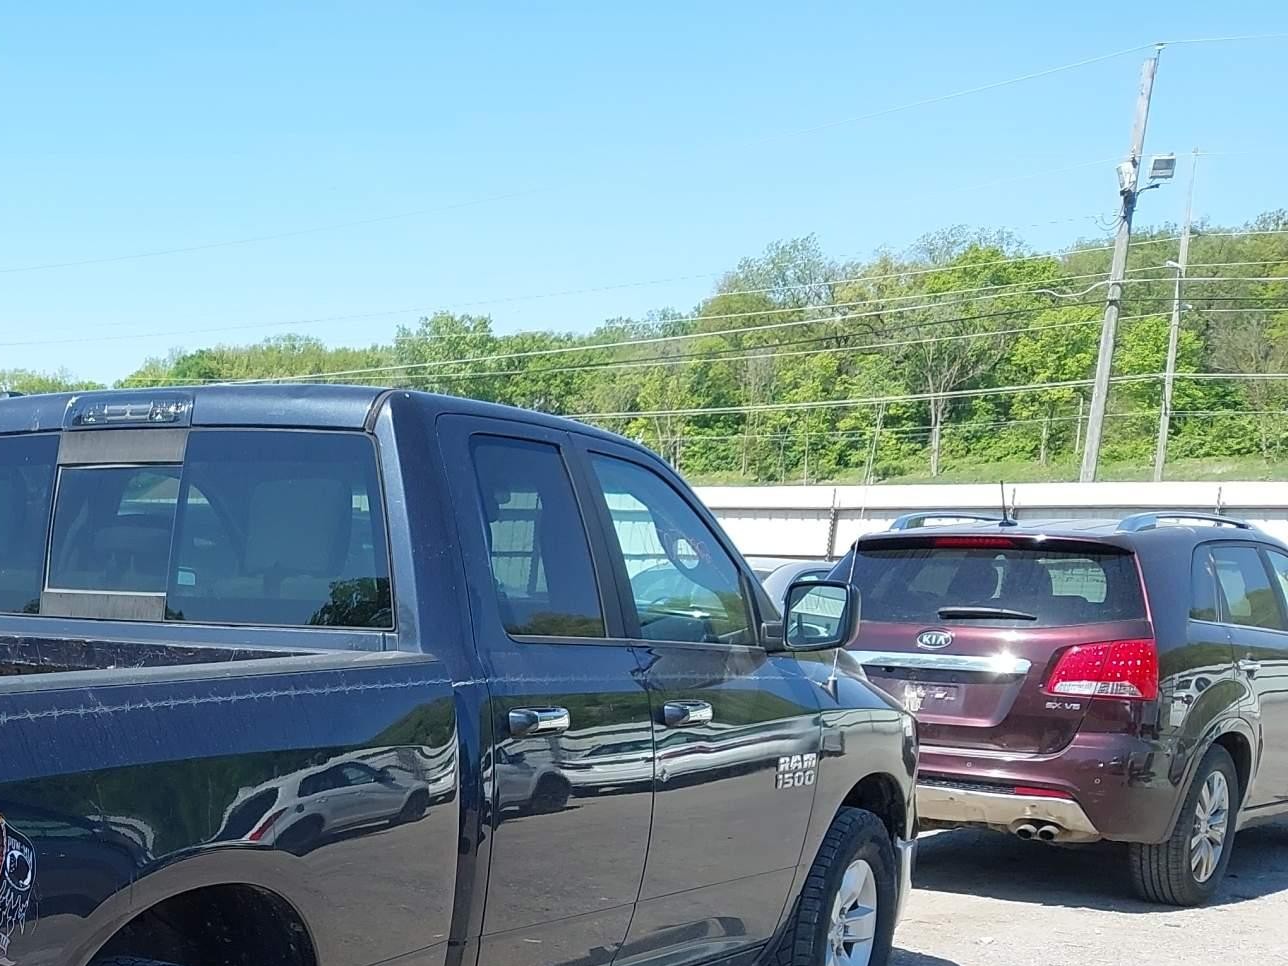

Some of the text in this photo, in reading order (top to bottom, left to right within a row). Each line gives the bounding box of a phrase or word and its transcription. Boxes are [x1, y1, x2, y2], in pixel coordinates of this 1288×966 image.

[922, 634, 946, 645] KIA
[778, 753, 817, 772] RAM
[777, 770, 815, 789] 1500
